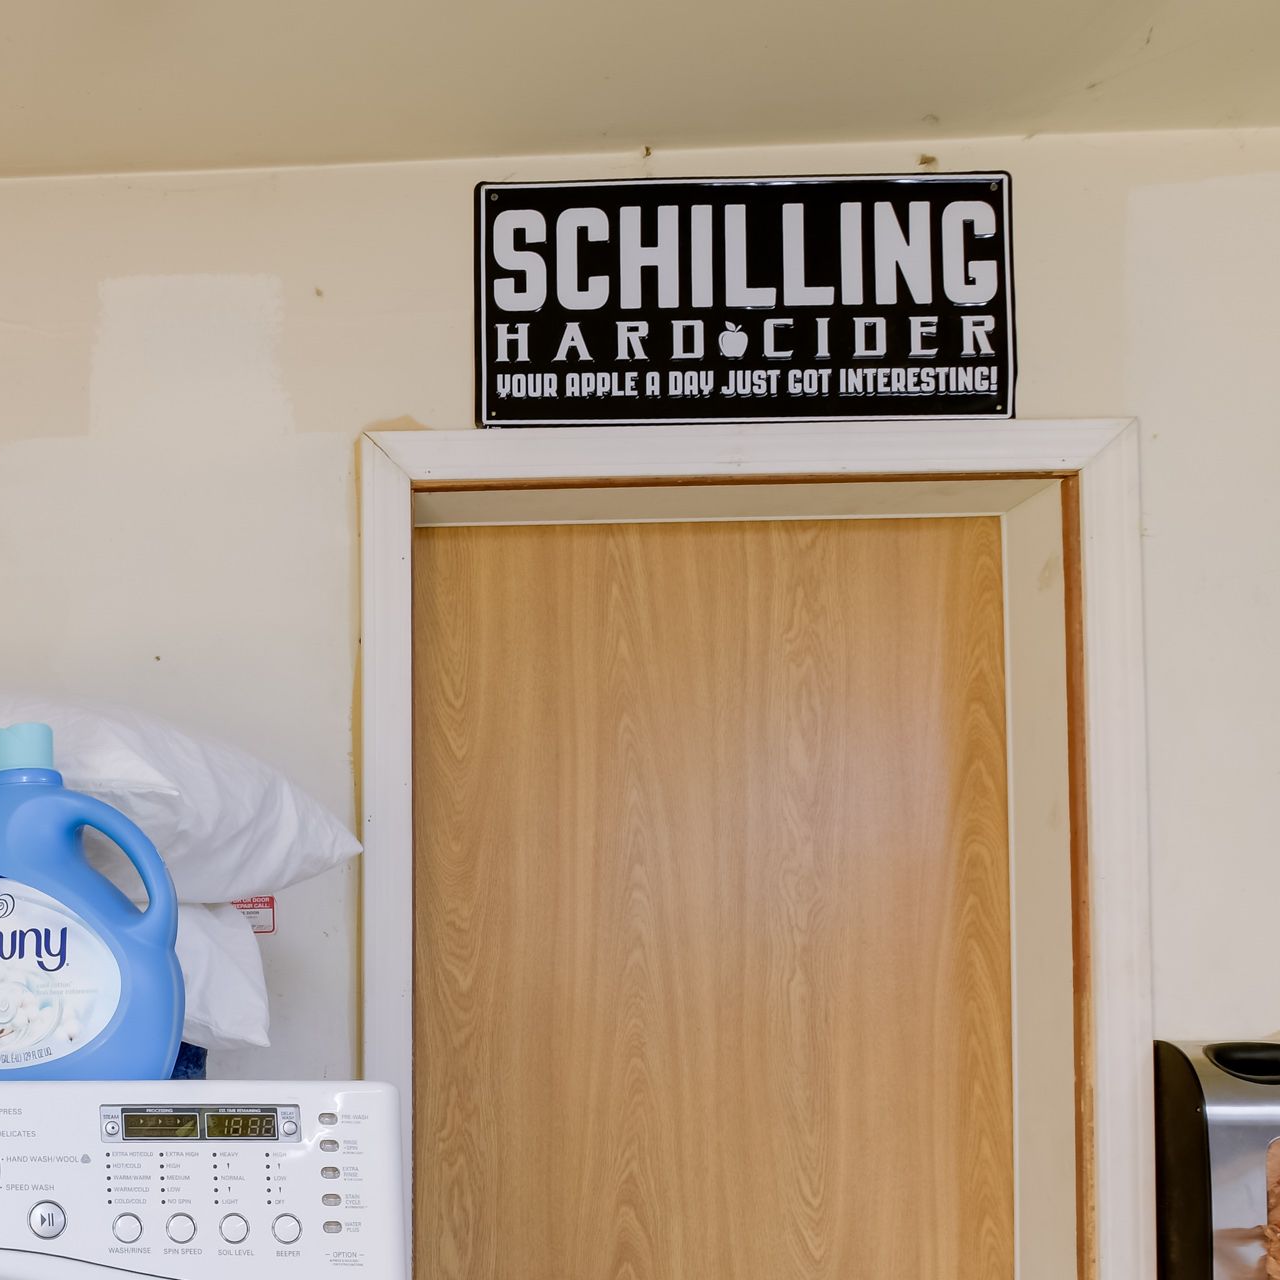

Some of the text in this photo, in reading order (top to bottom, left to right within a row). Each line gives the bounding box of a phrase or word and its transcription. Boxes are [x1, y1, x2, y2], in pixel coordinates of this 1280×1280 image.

[492, 200, 999, 313] SCHILLING
[494, 314, 996, 363] HARD CIDER
[496, 365, 999, 398] YOUR APPLE A DAY JUST GOT INTERESTING!
[6, 1155, 80, 1163] HAND WASH/WOOL
